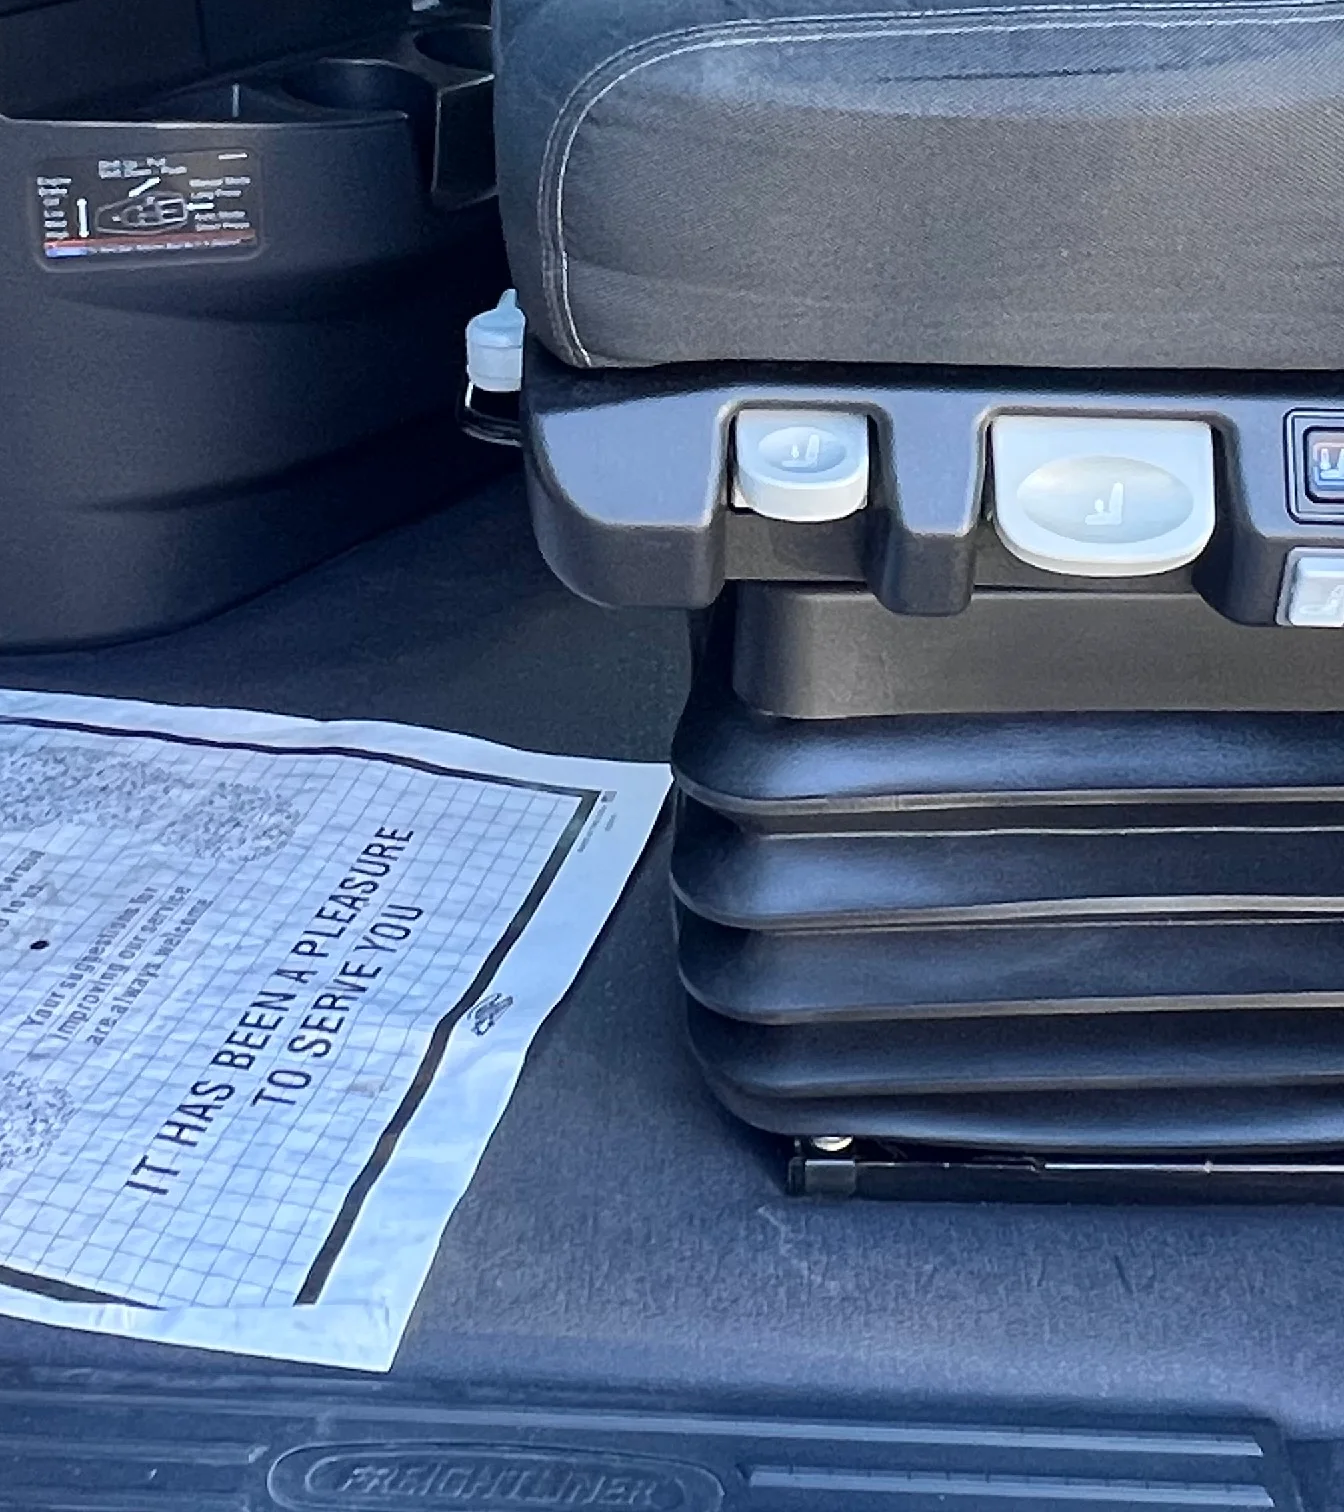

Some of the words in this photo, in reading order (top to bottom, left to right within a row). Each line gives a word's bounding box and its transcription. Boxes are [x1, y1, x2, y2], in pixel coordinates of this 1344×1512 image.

[291, 825, 415, 959] PLEASURE
[119, 935, 147, 960] our
[275, 968, 320, 986] A
[22, 991, 66, 1027] Your
[251, 1069, 313, 1108] TO
[288, 960, 383, 1058] SERVE
[354, 903, 424, 954] YOU
[86, 1017, 118, 1047] are
[211, 990, 297, 1071] BEEN
[156, 1080, 236, 1148] HAS
[124, 1155, 181, 1196] IT
